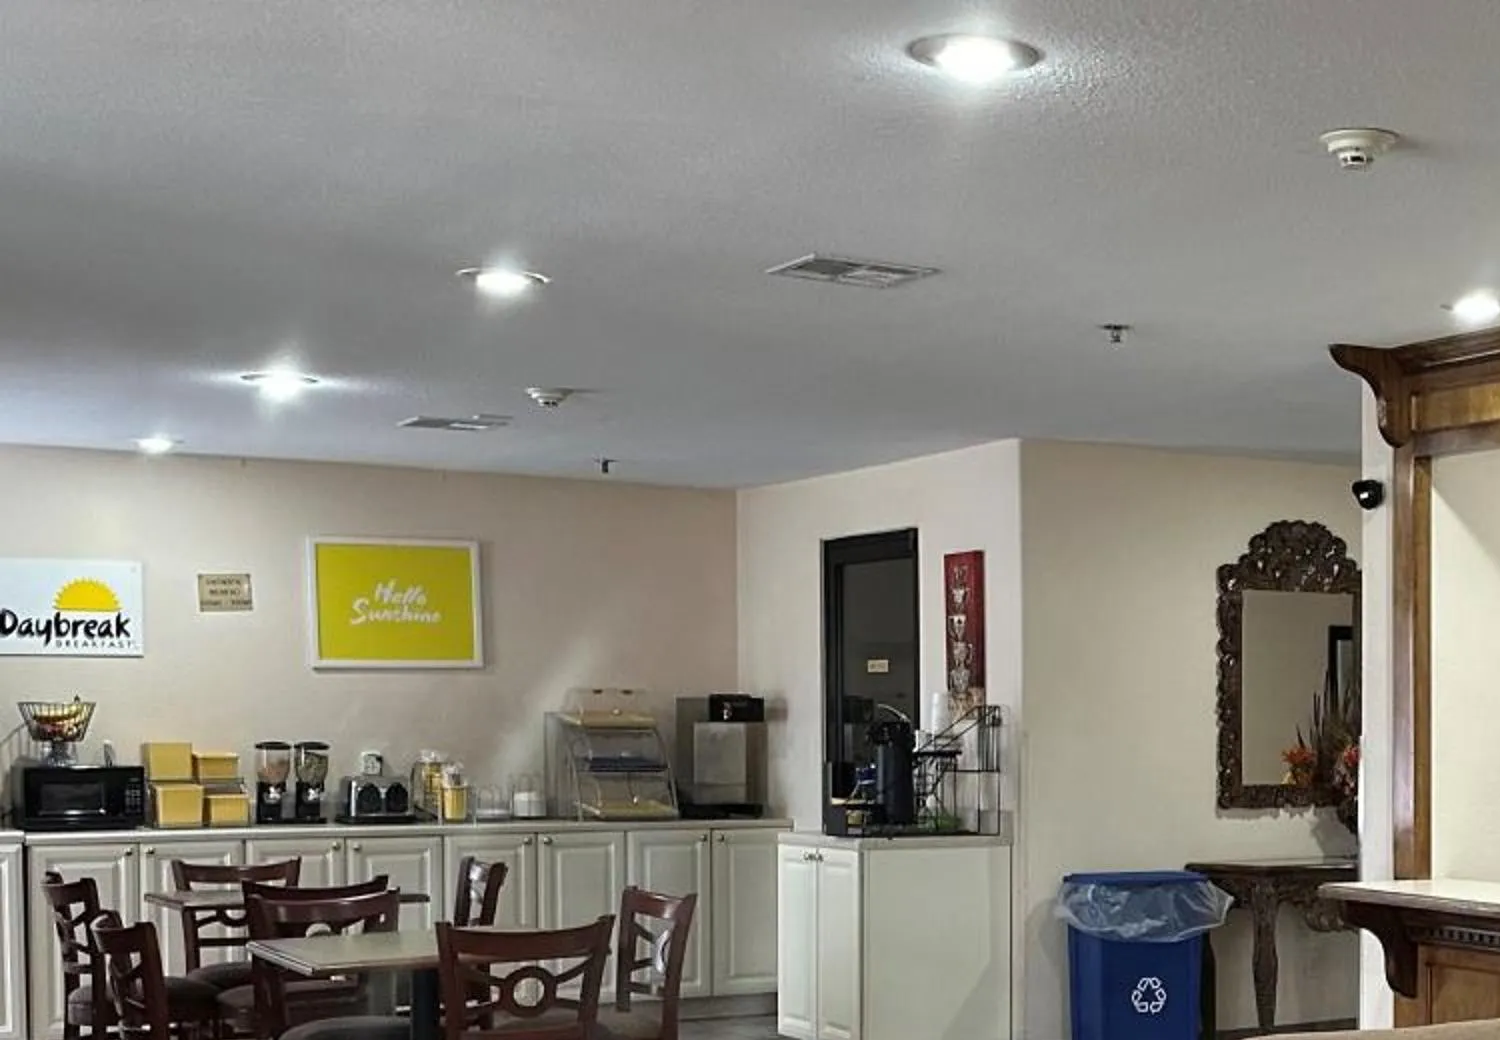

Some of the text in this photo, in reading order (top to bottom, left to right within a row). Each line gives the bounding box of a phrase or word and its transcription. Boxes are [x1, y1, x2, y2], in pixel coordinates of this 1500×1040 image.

[374, 577, 427, 605] Hello
[350, 597, 443, 625] Sunshine
[0, 607, 131, 647] Daybreak
[55, 640, 132, 649] BREAKFAST
